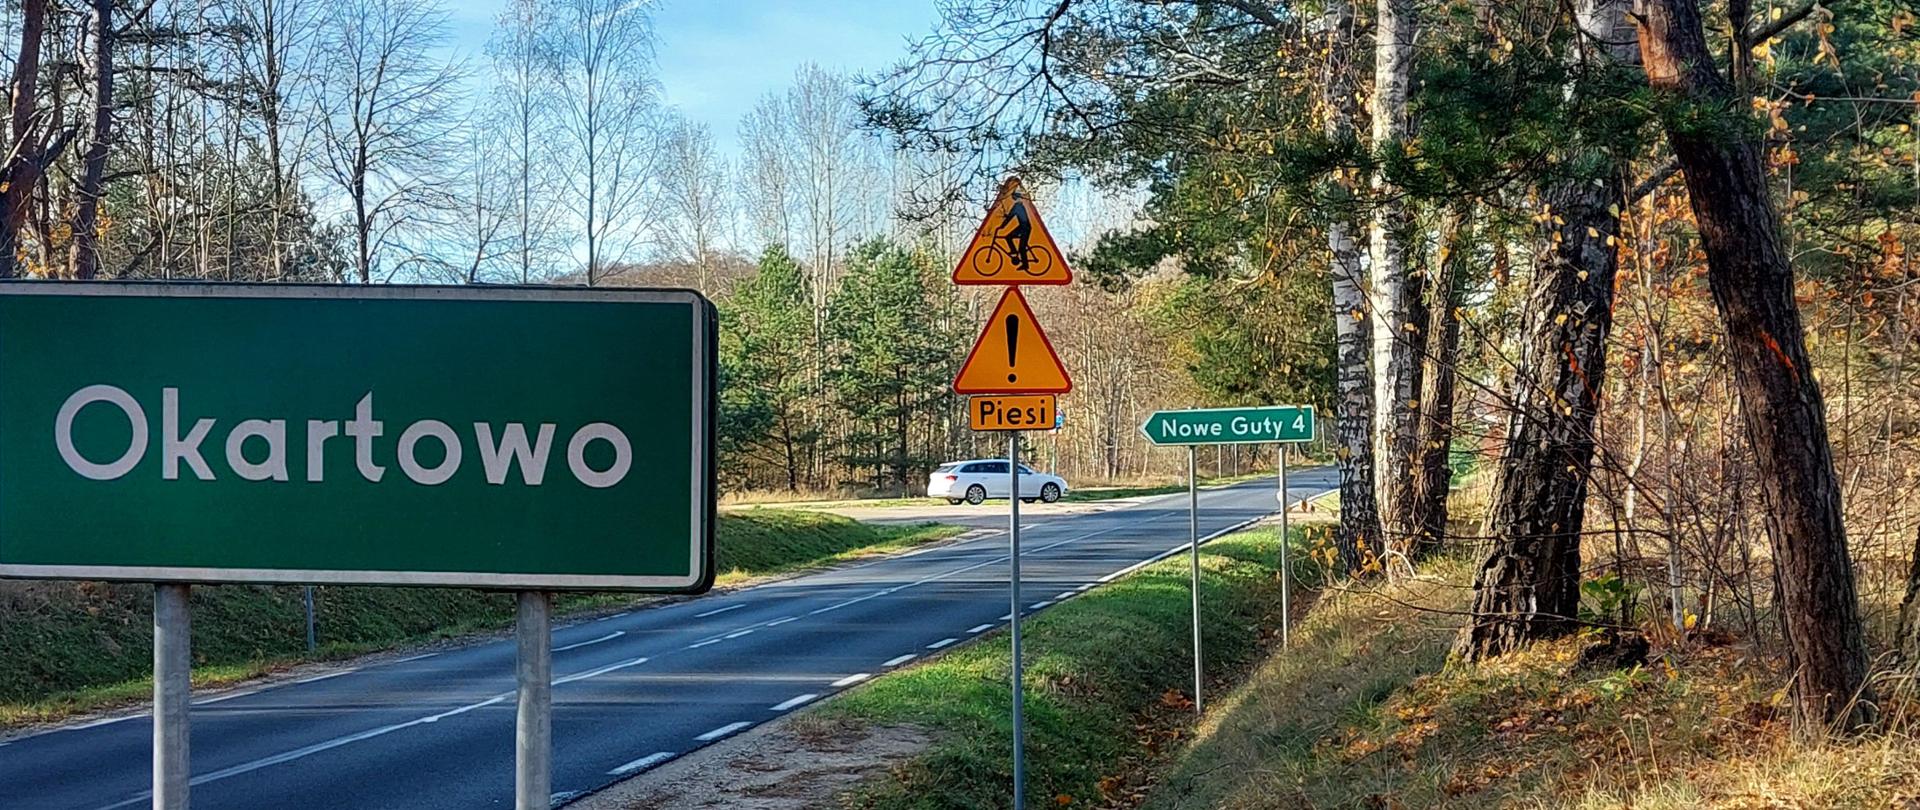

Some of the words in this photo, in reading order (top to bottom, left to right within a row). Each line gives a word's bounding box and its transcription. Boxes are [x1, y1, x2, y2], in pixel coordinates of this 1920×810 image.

[979, 398, 1046, 426] Piesi
[55, 384, 633, 488] Okartowo
[1161, 418, 1222, 438] Nowe
[1231, 415, 1283, 439] Guty
[1291, 414, 1305, 433] 4
